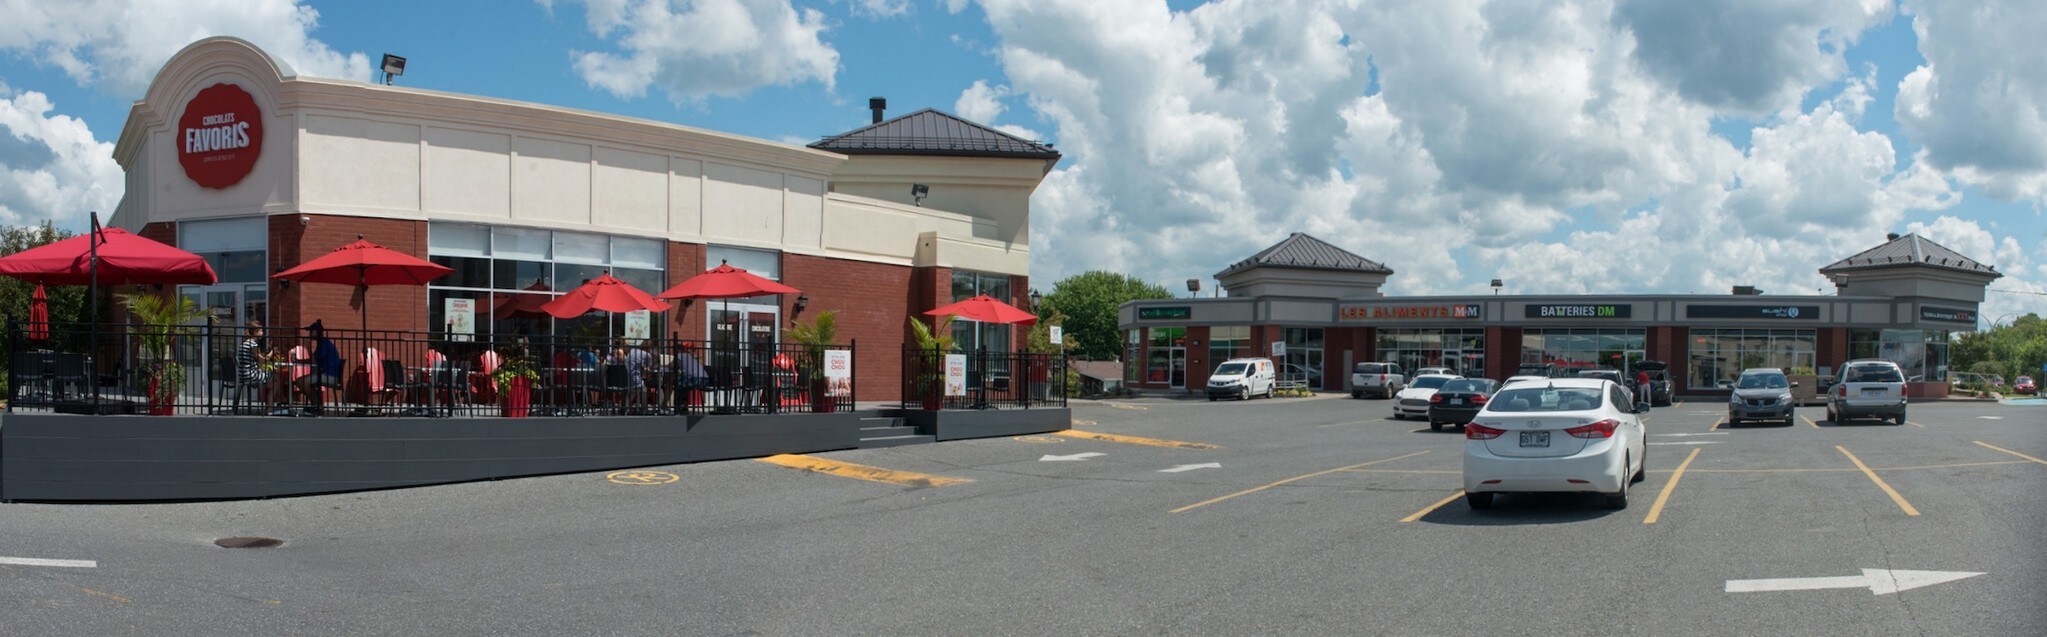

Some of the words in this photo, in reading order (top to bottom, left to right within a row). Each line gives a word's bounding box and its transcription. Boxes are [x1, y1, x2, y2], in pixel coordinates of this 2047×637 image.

[203, 113, 235, 126] CHOCOLATS
[186, 121, 250, 153] FAVORIS
[1340, 306, 1366, 319] LES
[1374, 306, 1448, 318] ALIMENTS
[1541, 306, 1595, 316] BATTERIES
[1597, 306, 1615, 316] DM
